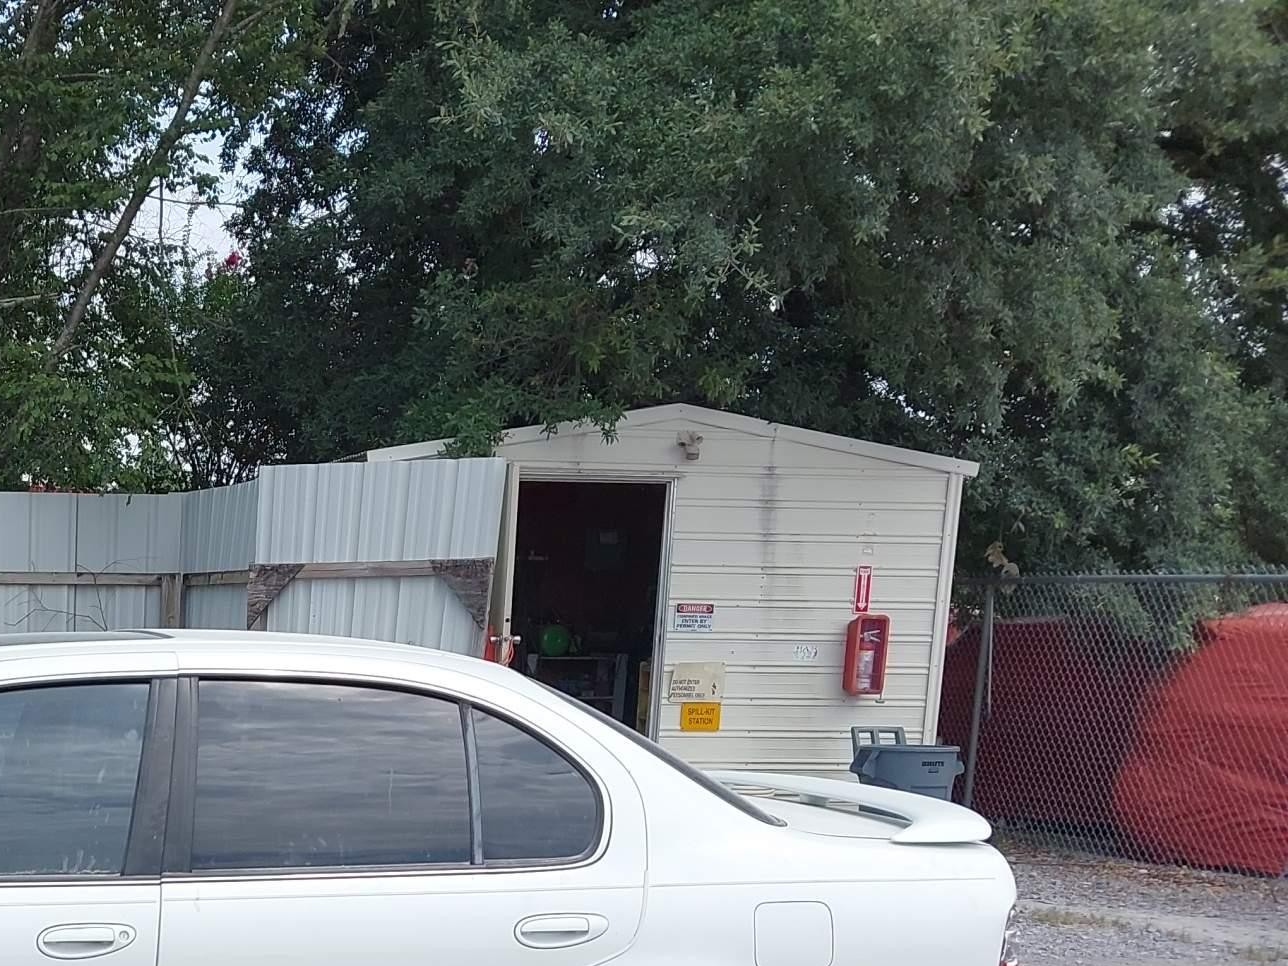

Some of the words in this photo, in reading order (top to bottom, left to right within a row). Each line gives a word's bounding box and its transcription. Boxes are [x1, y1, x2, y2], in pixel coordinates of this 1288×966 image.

[683, 604, 708, 612] DANGER
[687, 707, 716, 716] SPILL-KIT
[688, 717, 714, 726] STATION
